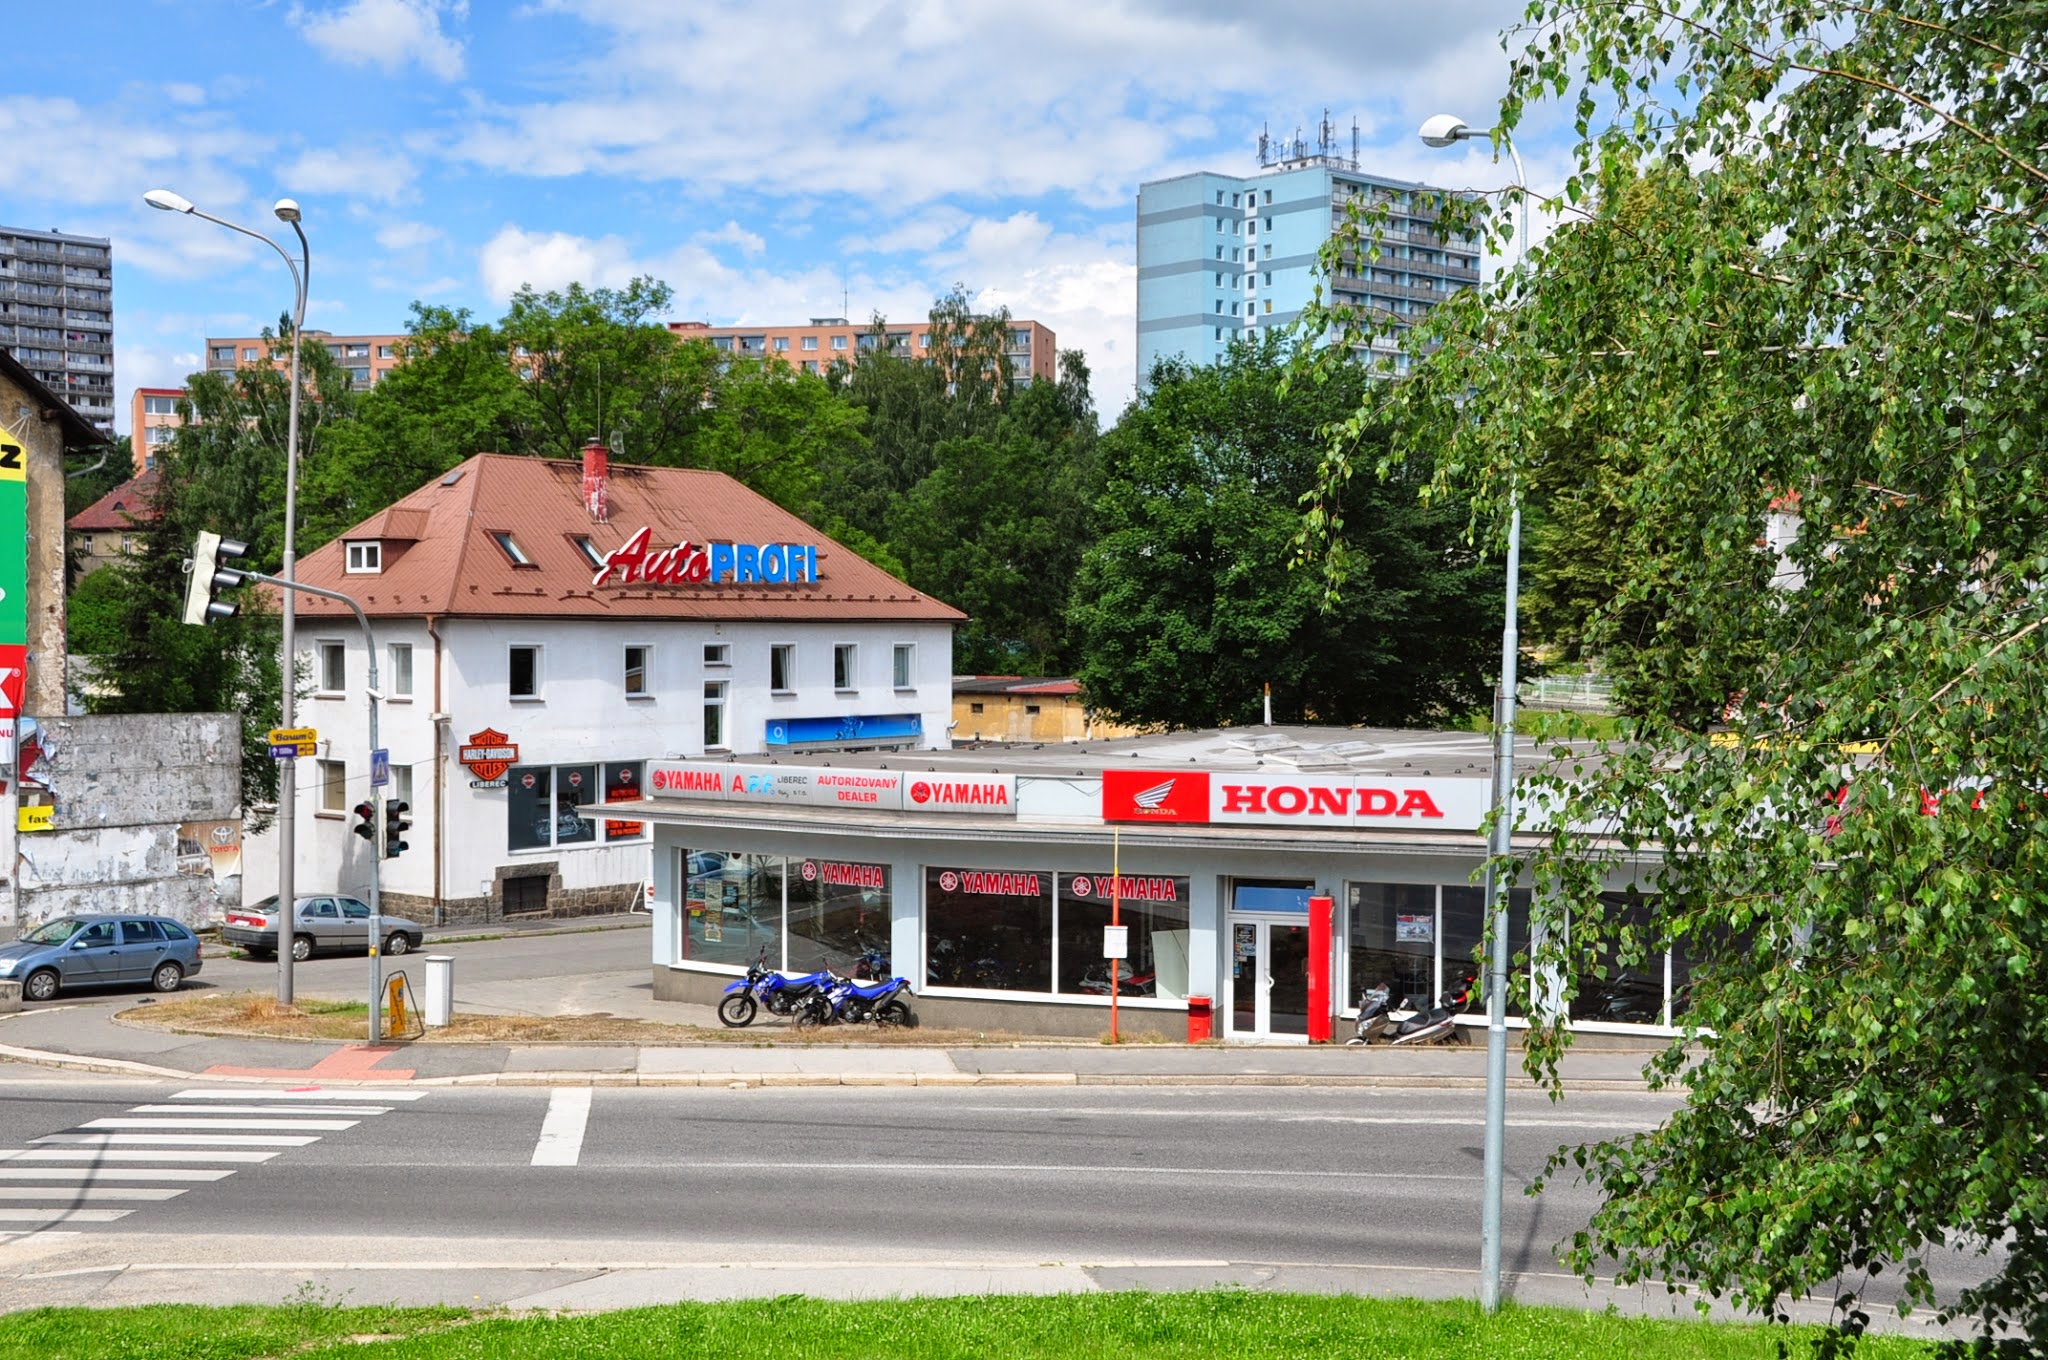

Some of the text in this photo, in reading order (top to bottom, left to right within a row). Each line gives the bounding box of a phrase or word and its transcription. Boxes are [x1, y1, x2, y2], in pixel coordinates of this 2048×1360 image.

[475, 762, 504, 777] CYCLES
[667, 770, 723, 792] YAMAHA
[817, 775, 897, 789] AUTORIZOVANÝ
[931, 782, 1008, 805] YAMAHA
[837, 791, 878, 803] DEALER
[1221, 785, 1444, 818] HONDA
[821, 862, 884, 889] YAMAHA
[960, 871, 1041, 897] YAMAHA
[1094, 876, 1177, 902] YAMAHA
